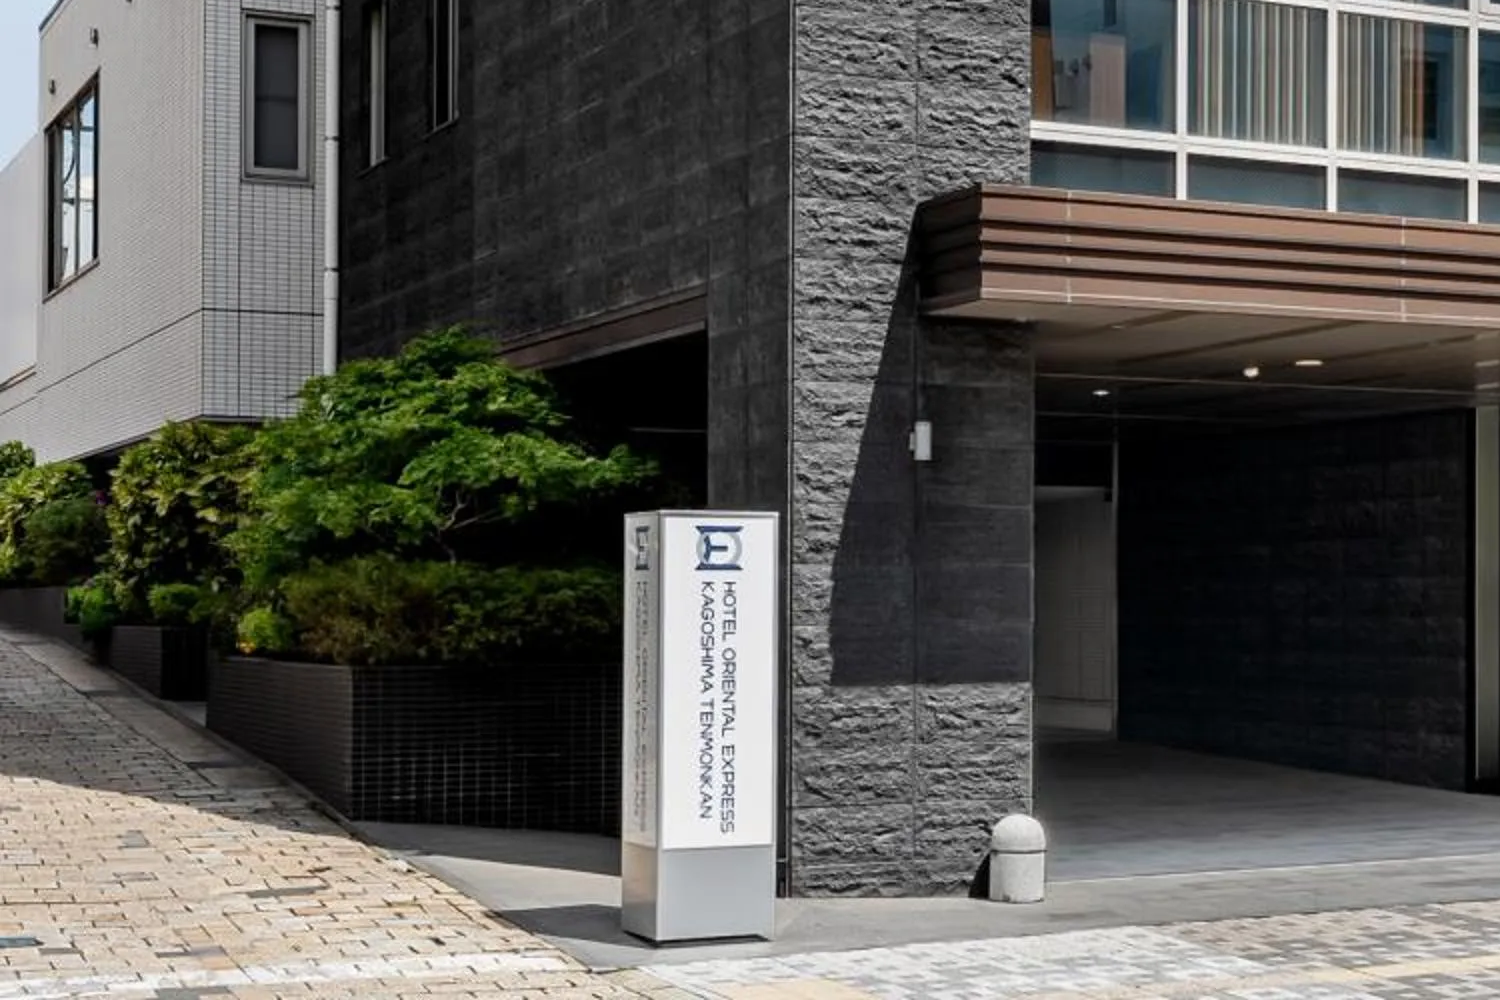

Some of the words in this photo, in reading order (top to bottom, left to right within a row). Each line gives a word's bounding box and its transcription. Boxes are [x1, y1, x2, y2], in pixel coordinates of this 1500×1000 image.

[700, 581, 715, 694] KAGOSHIMA
[722, 581, 737, 642] HOTEL
[721, 647, 736, 737] ORIENTAL
[699, 697, 715, 819] TENMONKAN
[720, 744, 736, 833] EXPRESS
